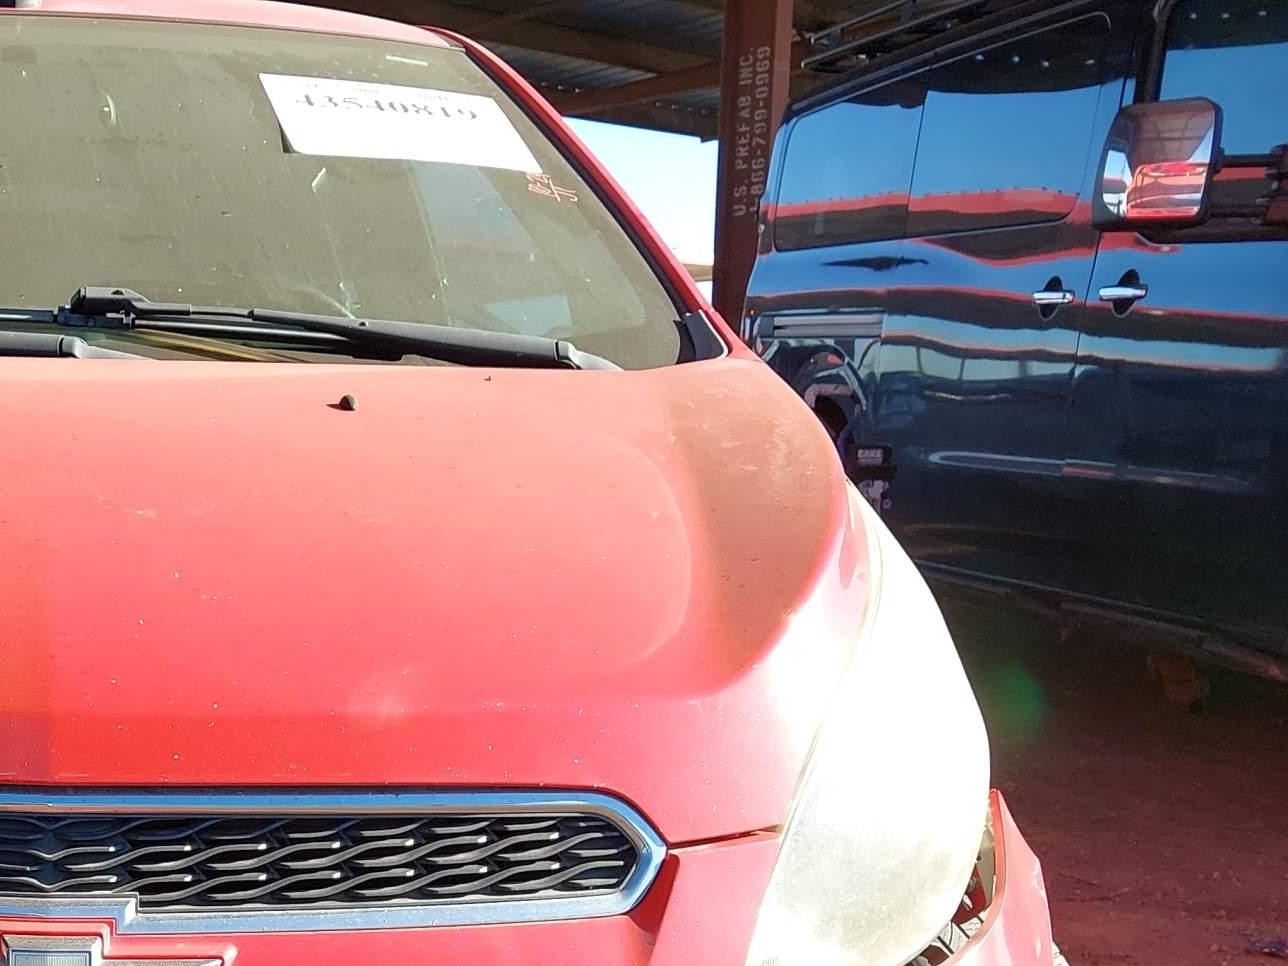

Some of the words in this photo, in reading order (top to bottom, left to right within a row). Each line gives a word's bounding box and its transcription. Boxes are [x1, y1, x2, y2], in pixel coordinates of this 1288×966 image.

[739, 48, 754, 86] INC.
[735, 95, 751, 170] PREFAB
[731, 179, 748, 217] U.S.
